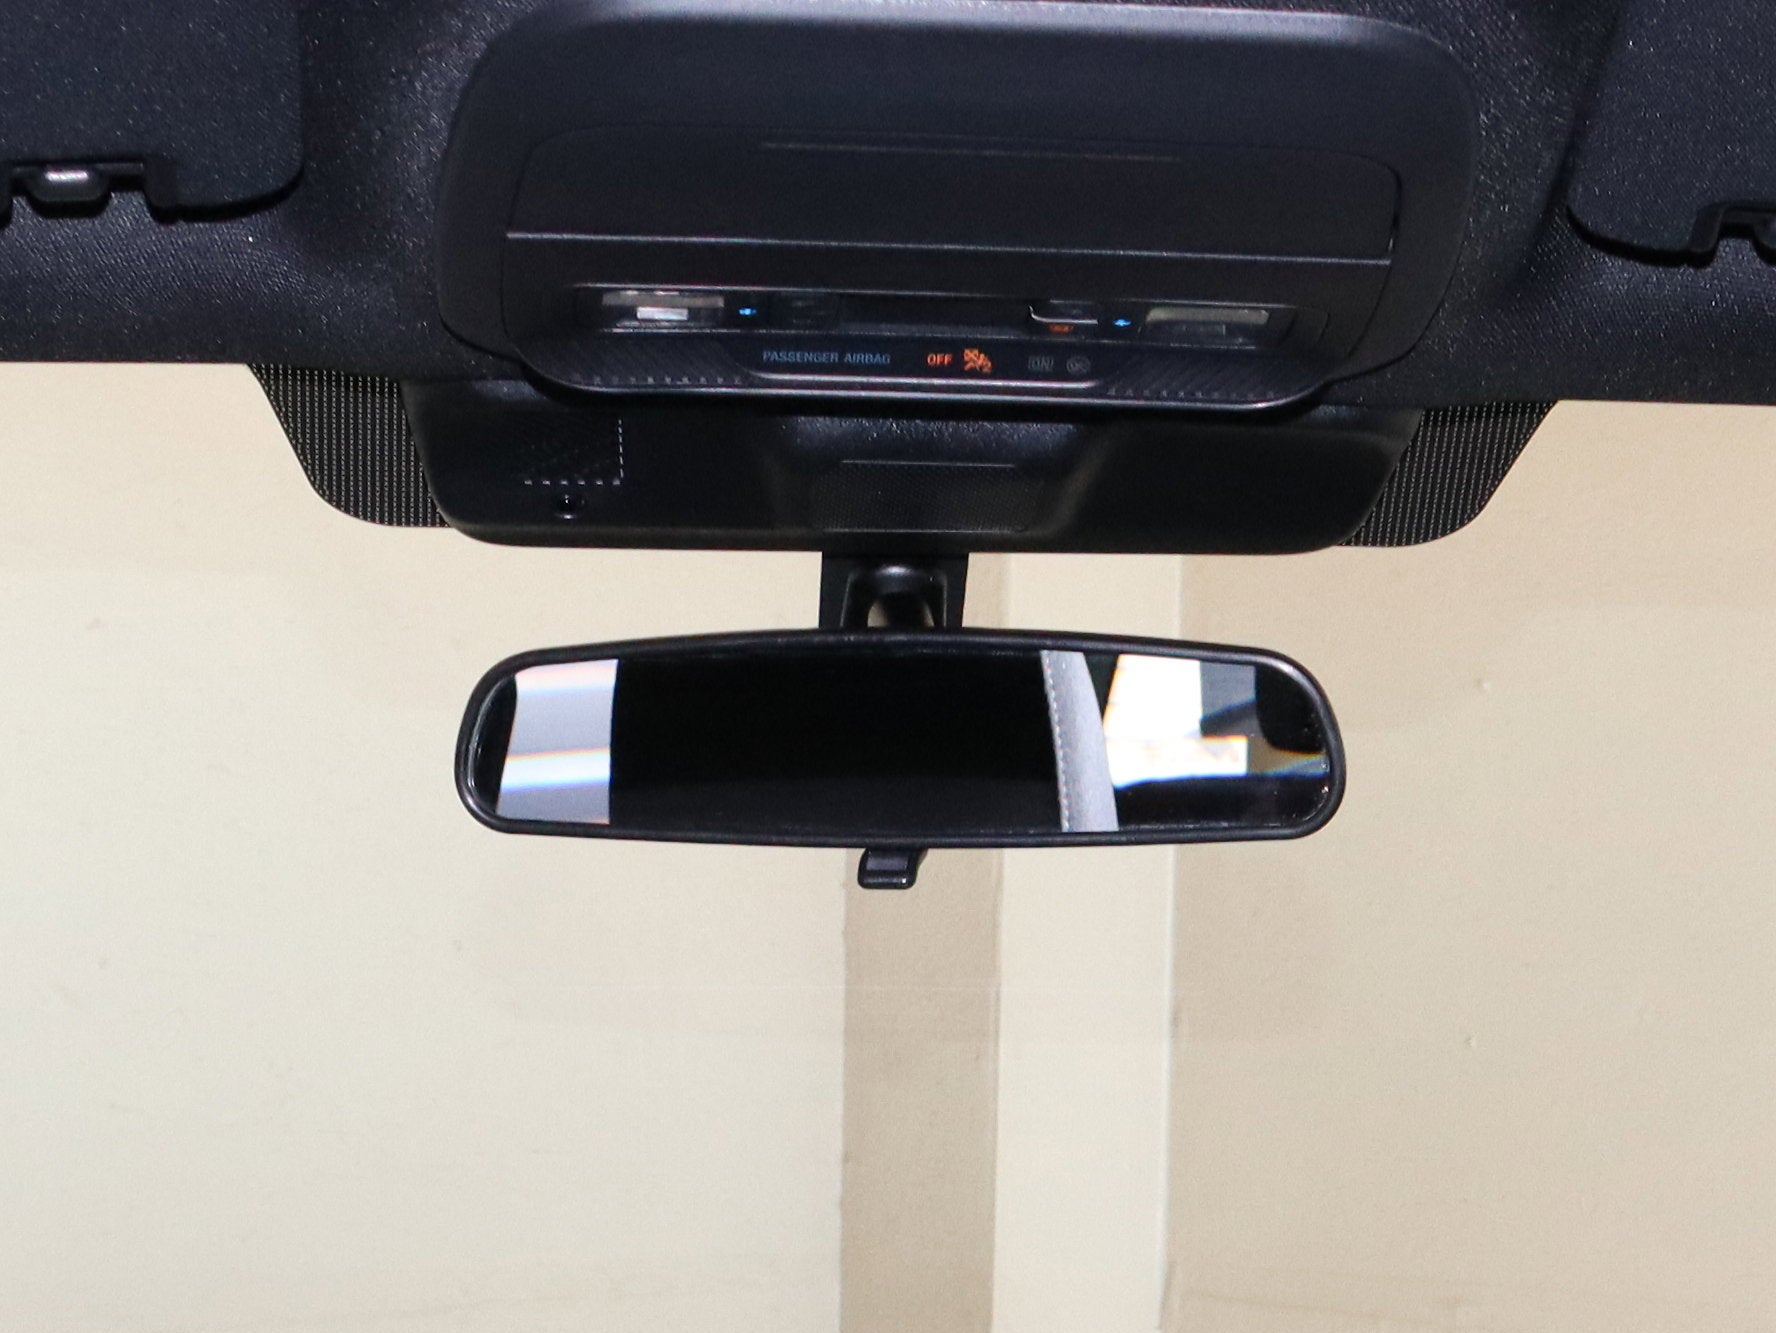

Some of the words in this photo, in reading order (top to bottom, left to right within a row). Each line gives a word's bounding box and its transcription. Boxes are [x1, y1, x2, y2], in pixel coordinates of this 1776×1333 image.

[762, 350, 839, 364] PASSENGER
[844, 353, 891, 364] AIRBAG
[927, 353, 952, 366] OFF
